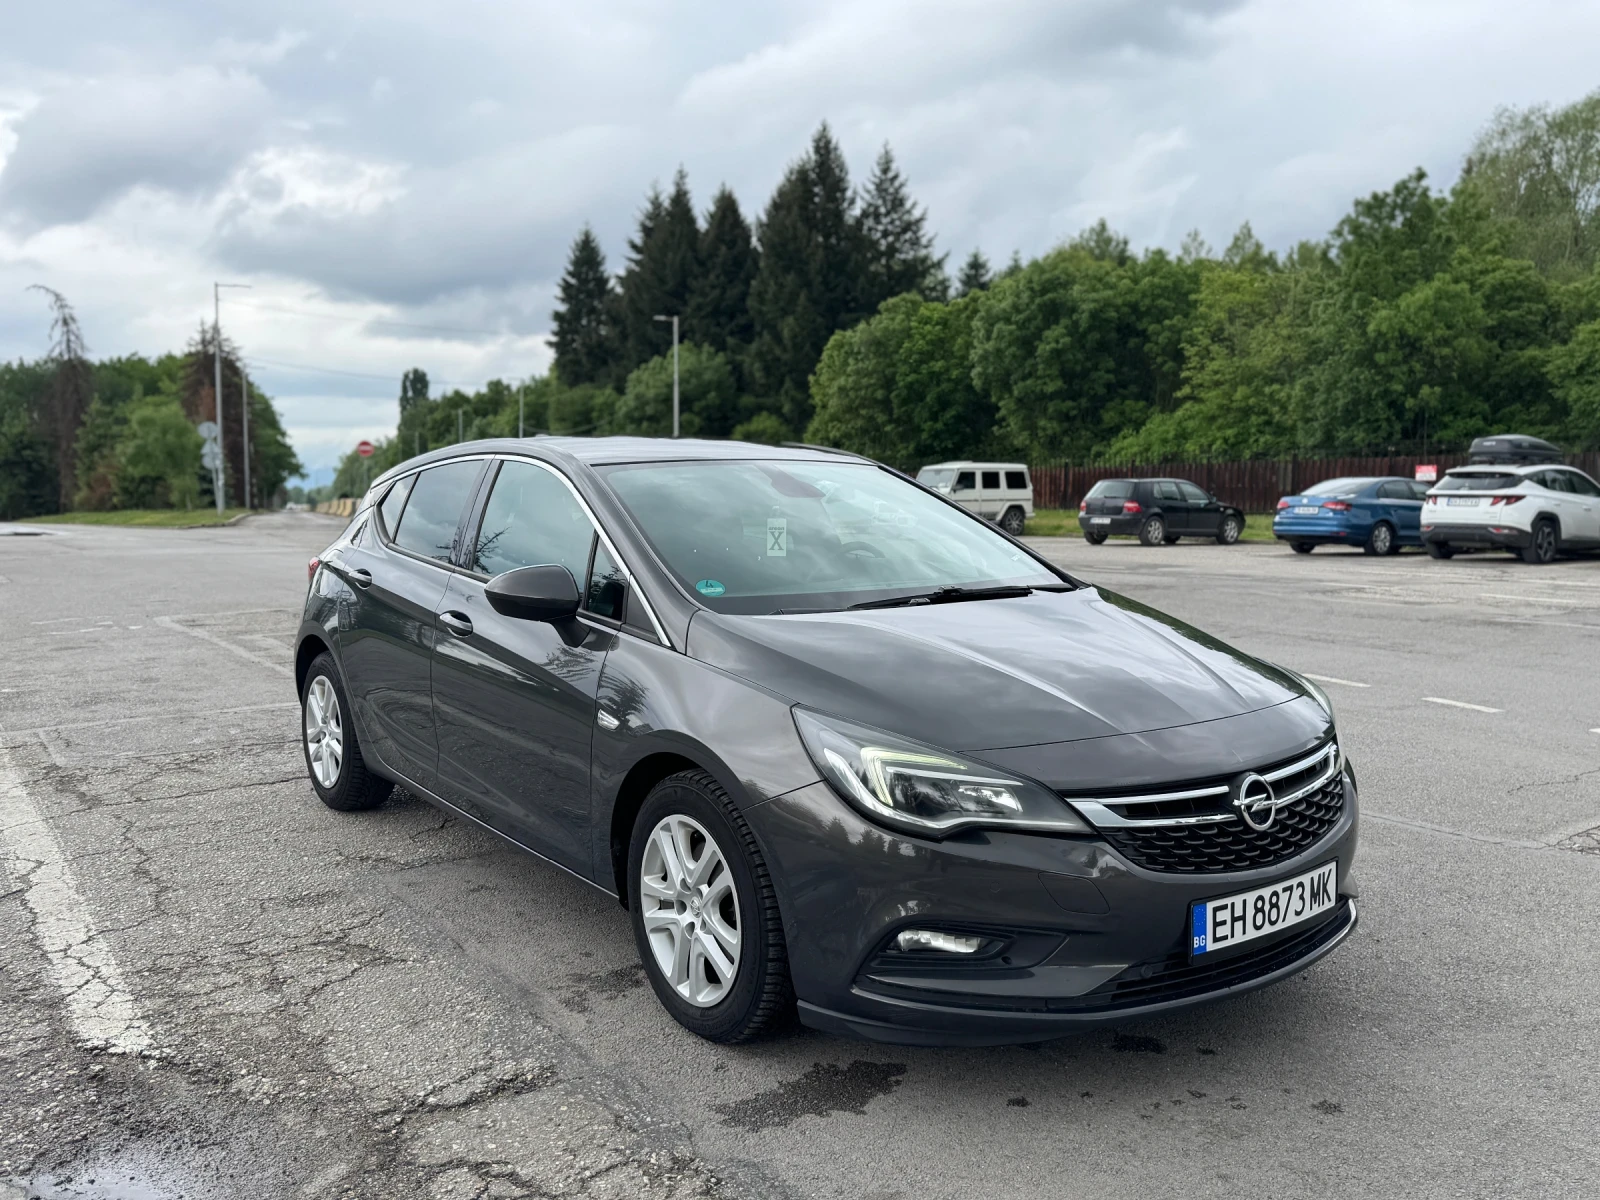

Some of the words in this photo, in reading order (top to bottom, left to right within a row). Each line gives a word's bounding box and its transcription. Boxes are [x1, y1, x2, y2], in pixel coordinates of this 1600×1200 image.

[768, 531, 785, 551] X
[1212, 898, 1247, 944] EH
[1252, 881, 1306, 931] 8873
[1309, 868, 1332, 911] MK
[1193, 935, 1206, 948] BG
